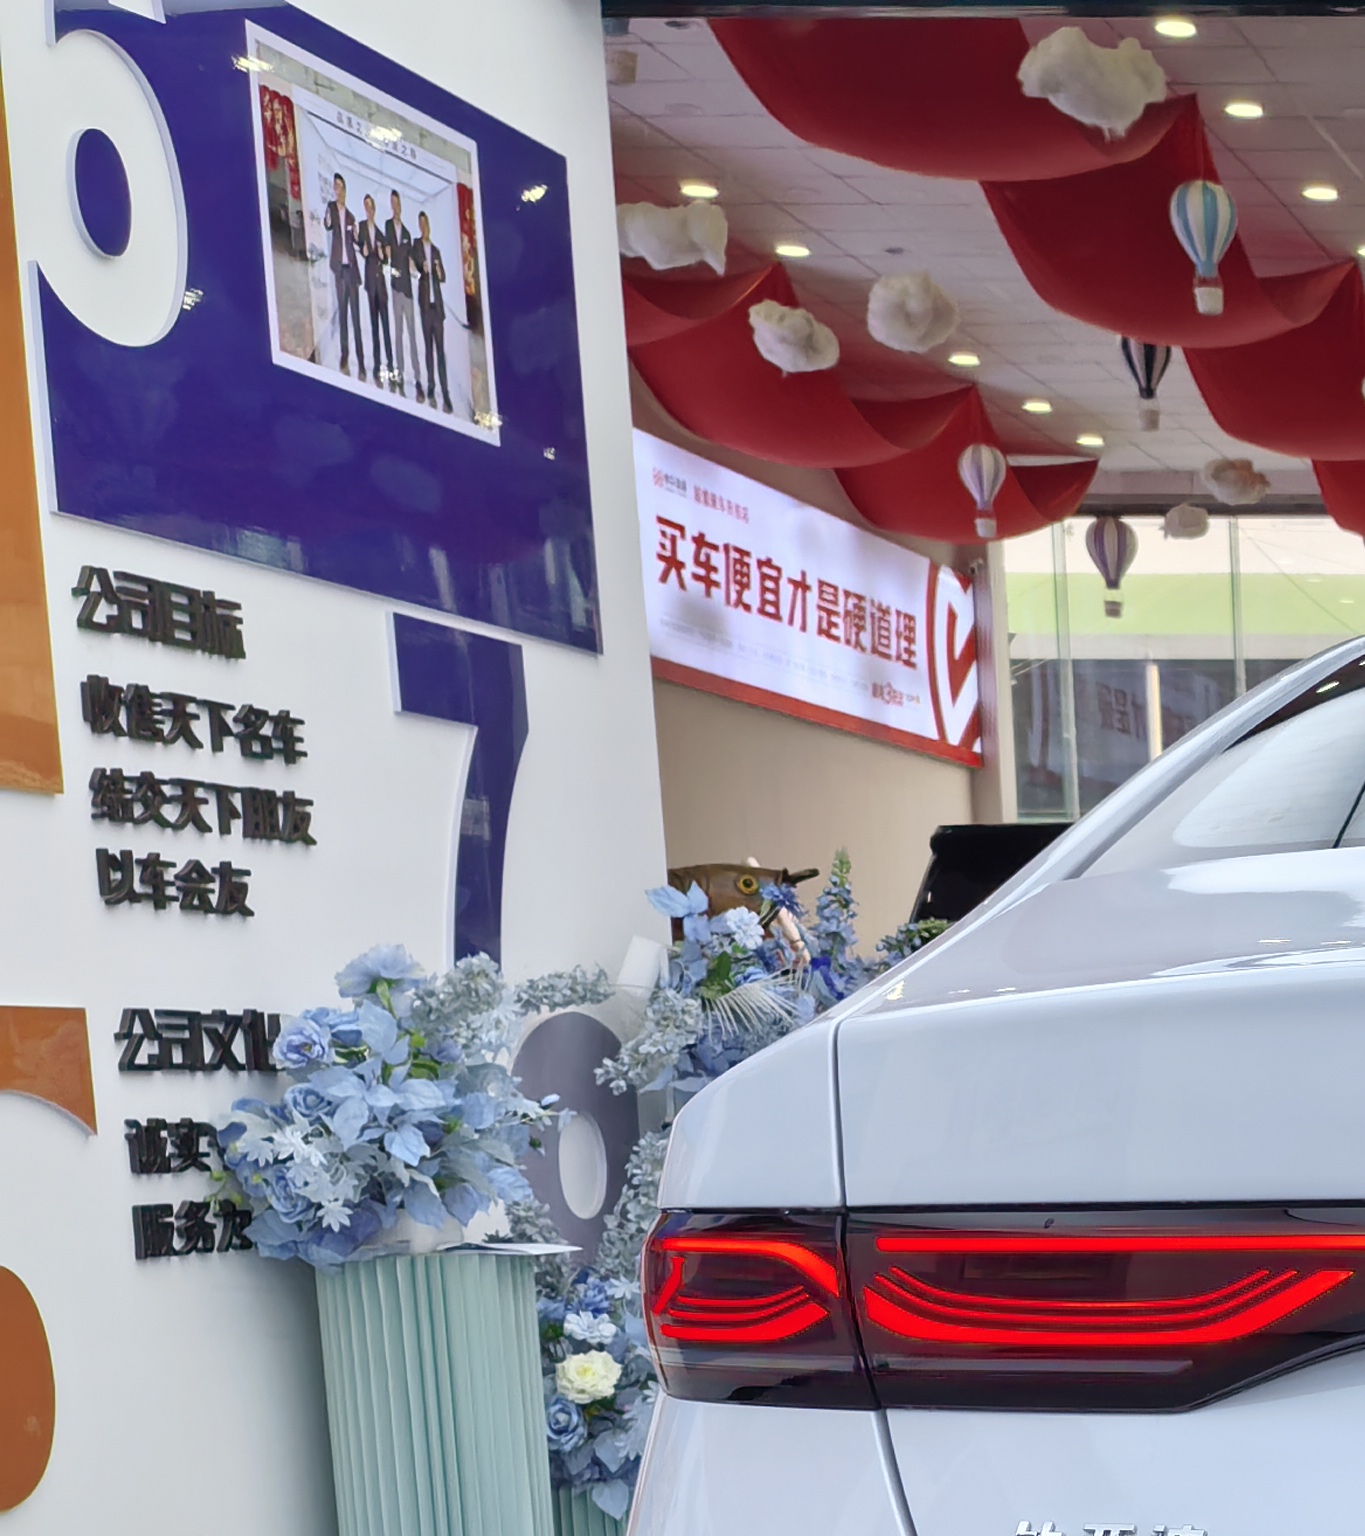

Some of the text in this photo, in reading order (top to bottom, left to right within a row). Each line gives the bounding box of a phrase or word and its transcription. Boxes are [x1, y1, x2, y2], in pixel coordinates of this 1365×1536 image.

[71, 565, 247, 660] 公司目标
[656, 514, 918, 670] 买车便宜才是硬道理
[80, 674, 309, 765] 收售天下名车
[89, 767, 318, 846] 结交天下朋友
[96, 848, 256, 918] 以车会友
[114, 1008, 285, 1072] 公司文化
[124, 1117, 229, 1174] 诚实
